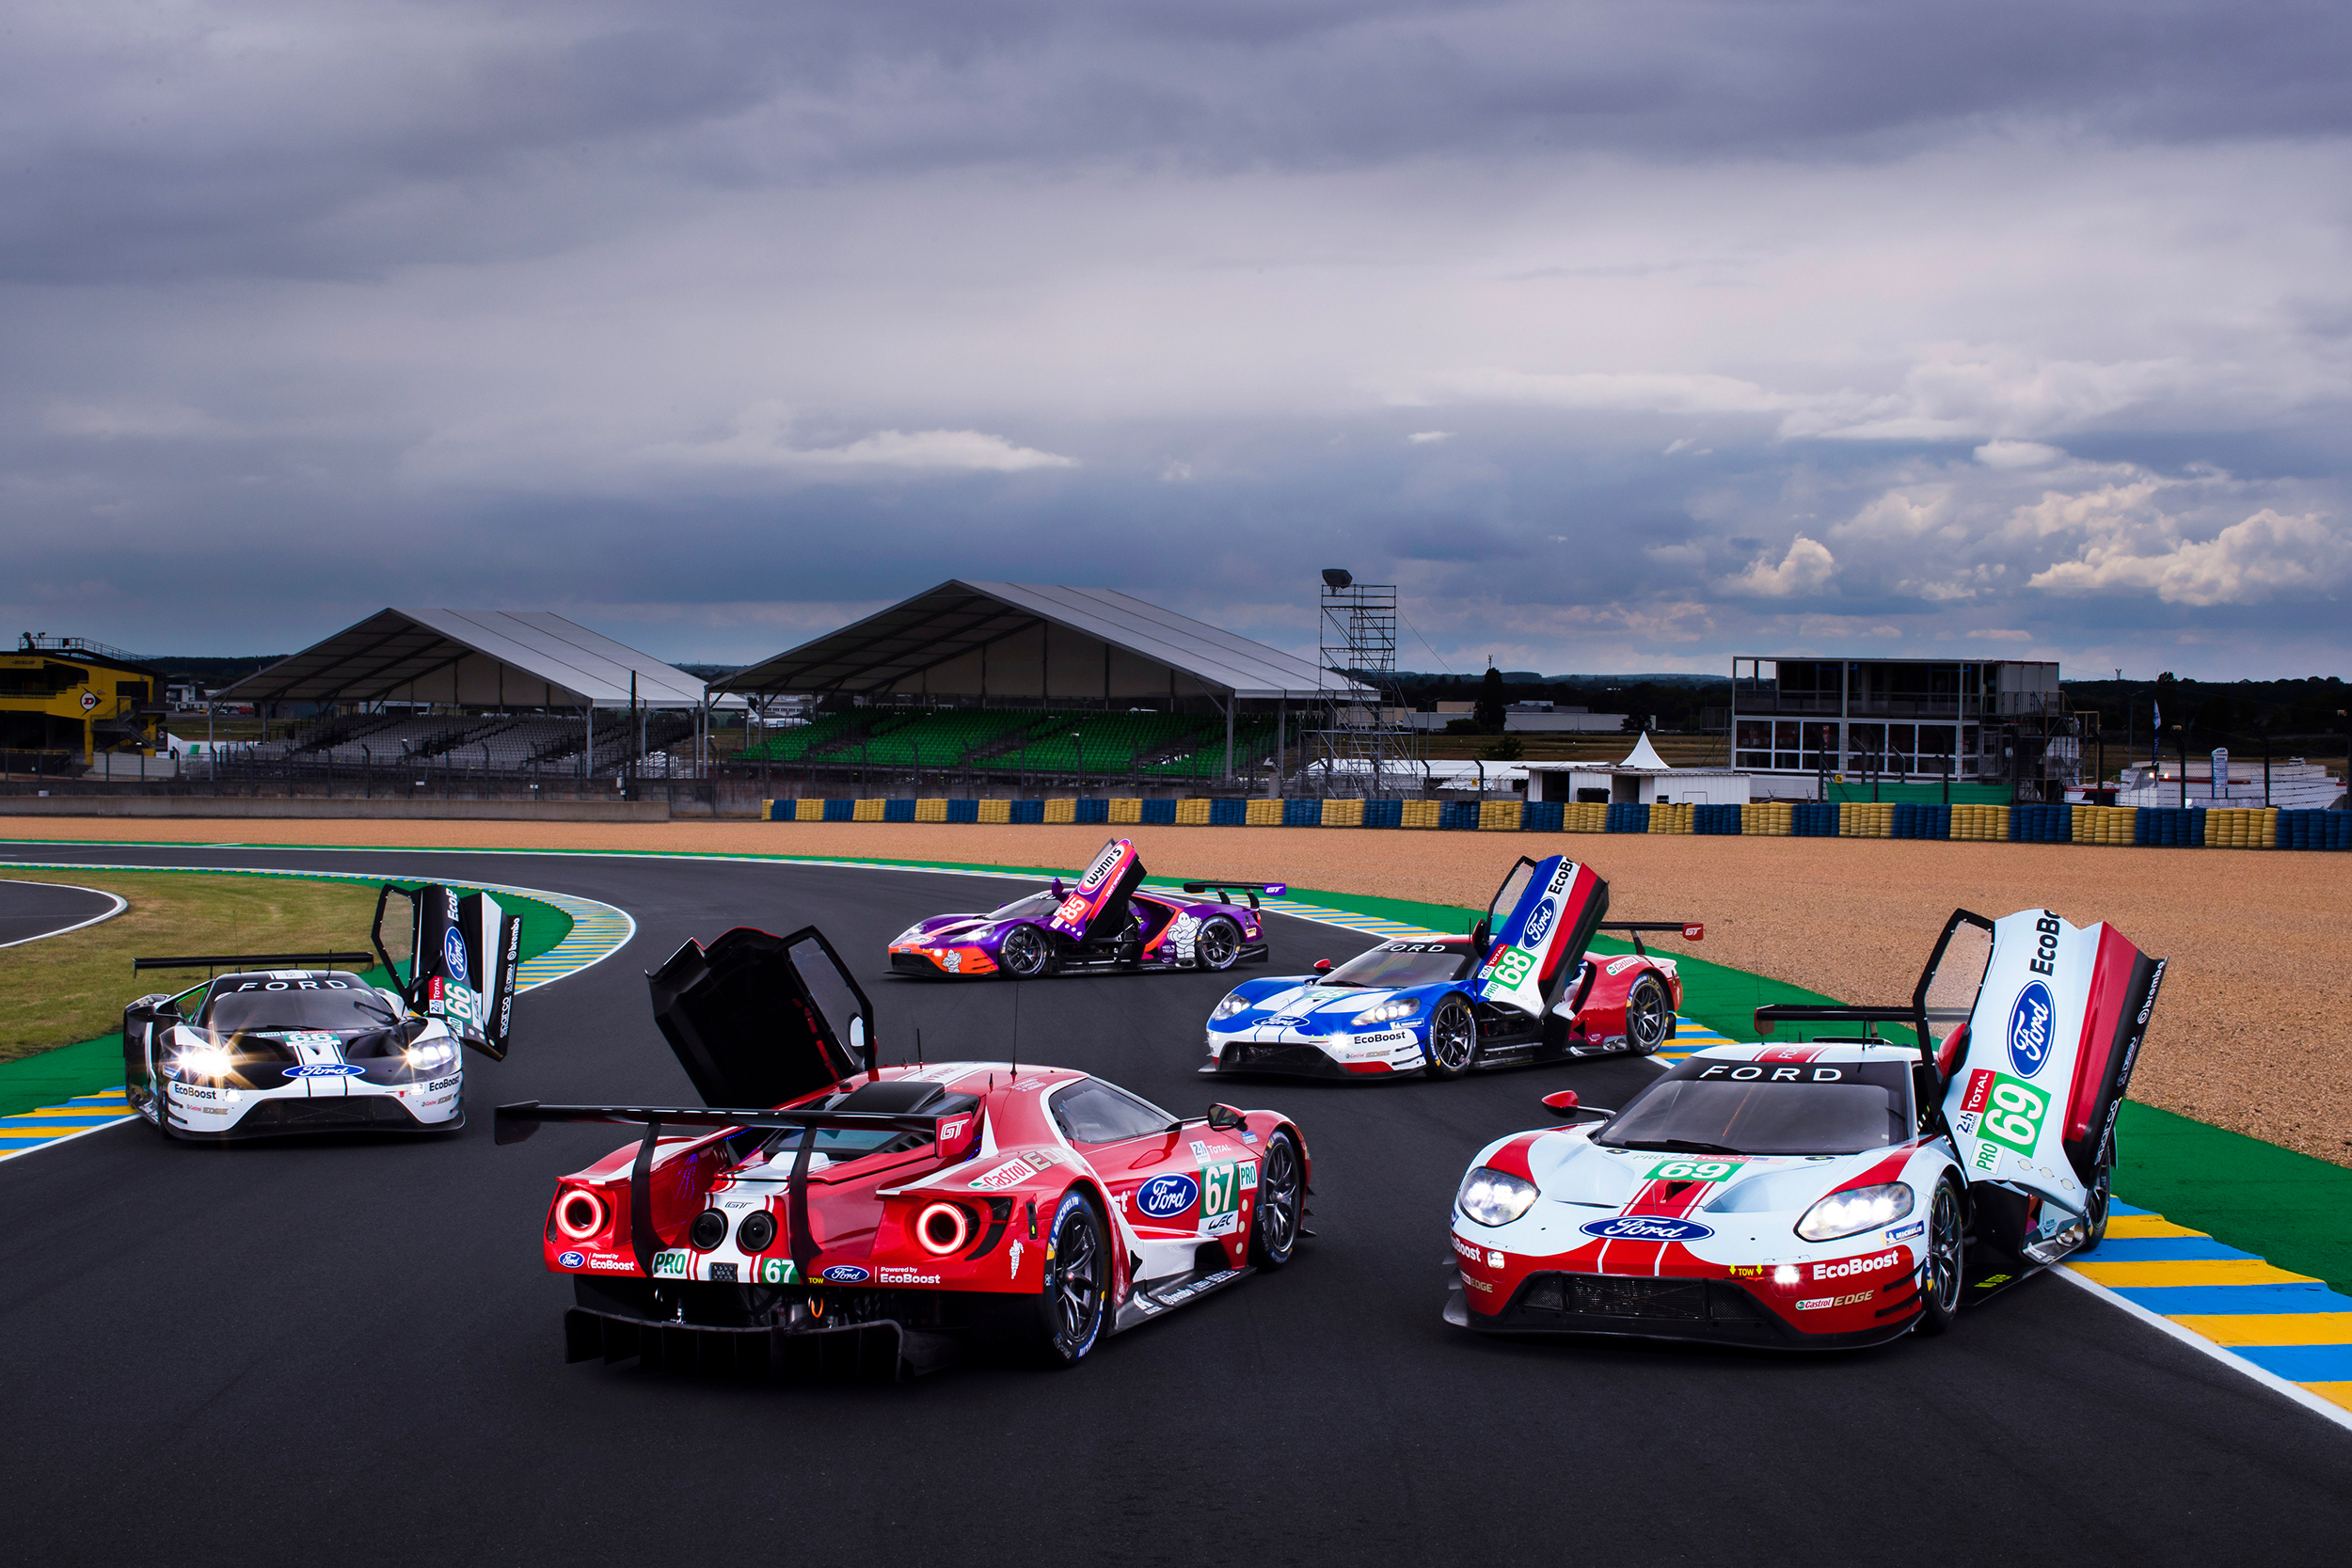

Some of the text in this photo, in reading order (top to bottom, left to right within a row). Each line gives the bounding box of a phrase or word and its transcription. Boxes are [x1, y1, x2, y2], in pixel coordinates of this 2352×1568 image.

[1061, 896, 1086, 920] 85
[509, 917, 520, 951] brembo
[1526, 906, 1552, 942] Ford
[1684, 927, 1702, 936] GT
[448, 935, 465, 972] Ford
[1376, 943, 1446, 953] FORD
[1488, 944, 1506, 966] TOTAL
[1494, 951, 1532, 985] 68
[1613, 957, 1635, 971] Castrol
[237, 979, 349, 992] FORD
[1311, 990, 1350, 998] 68
[1484, 983, 1499, 998] PRO
[2143, 961, 2165, 1008] brembo
[444, 983, 471, 1019] 66
[500, 996, 510, 1038] sparco
[1260, 1016, 1300, 1026] Ford
[289, 1033, 333, 1042] 66
[1354, 1031, 1406, 1044] EcoBoost
[2013, 998, 2049, 1061] Ford
[298, 1065, 349, 1076] Ford
[1698, 1065, 1842, 1082] FORD
[174, 1084, 217, 1100] EcoBoost
[429, 1075, 460, 1092] EcoBoost
[1967, 1072, 1989, 1110] TOTAL
[1956, 1113, 1974, 1133] 24h
[1985, 1083, 2043, 1145] 69
[941, 1118, 970, 1140] GT
[2094, 1100, 2118, 1165] sparco
[1207, 1144, 1232, 1154] TOTAL
[1976, 1143, 1997, 1170] PRO
[983, 1162, 1032, 1189] Castrol
[1240, 1165, 1257, 1186] PRO
[1658, 1162, 1731, 1179] 69
[1148, 1180, 1188, 1211] Ford
[1205, 1163, 1234, 1215] 67
[1053, 1195, 1079, 1235] MICHELIN
[1603, 1218, 1689, 1238] Ford
[1896, 1225, 1922, 1240] MICHELIN
[561, 1253, 579, 1265] Ford
[590, 1259, 635, 1271] EcoBoost
[655, 1254, 686, 1275] PRO
[1813, 1249, 1899, 1280] EcoBoost
[765, 1259, 795, 1283] 67
[831, 1267, 861, 1280] Ford
[880, 1273, 941, 1284] EcoBoost
[1738, 1268, 1755, 1276] TOW
[1470, 1277, 1494, 1293] EDGE
[1804, 1290, 1875, 1309] Castrol EDGE
